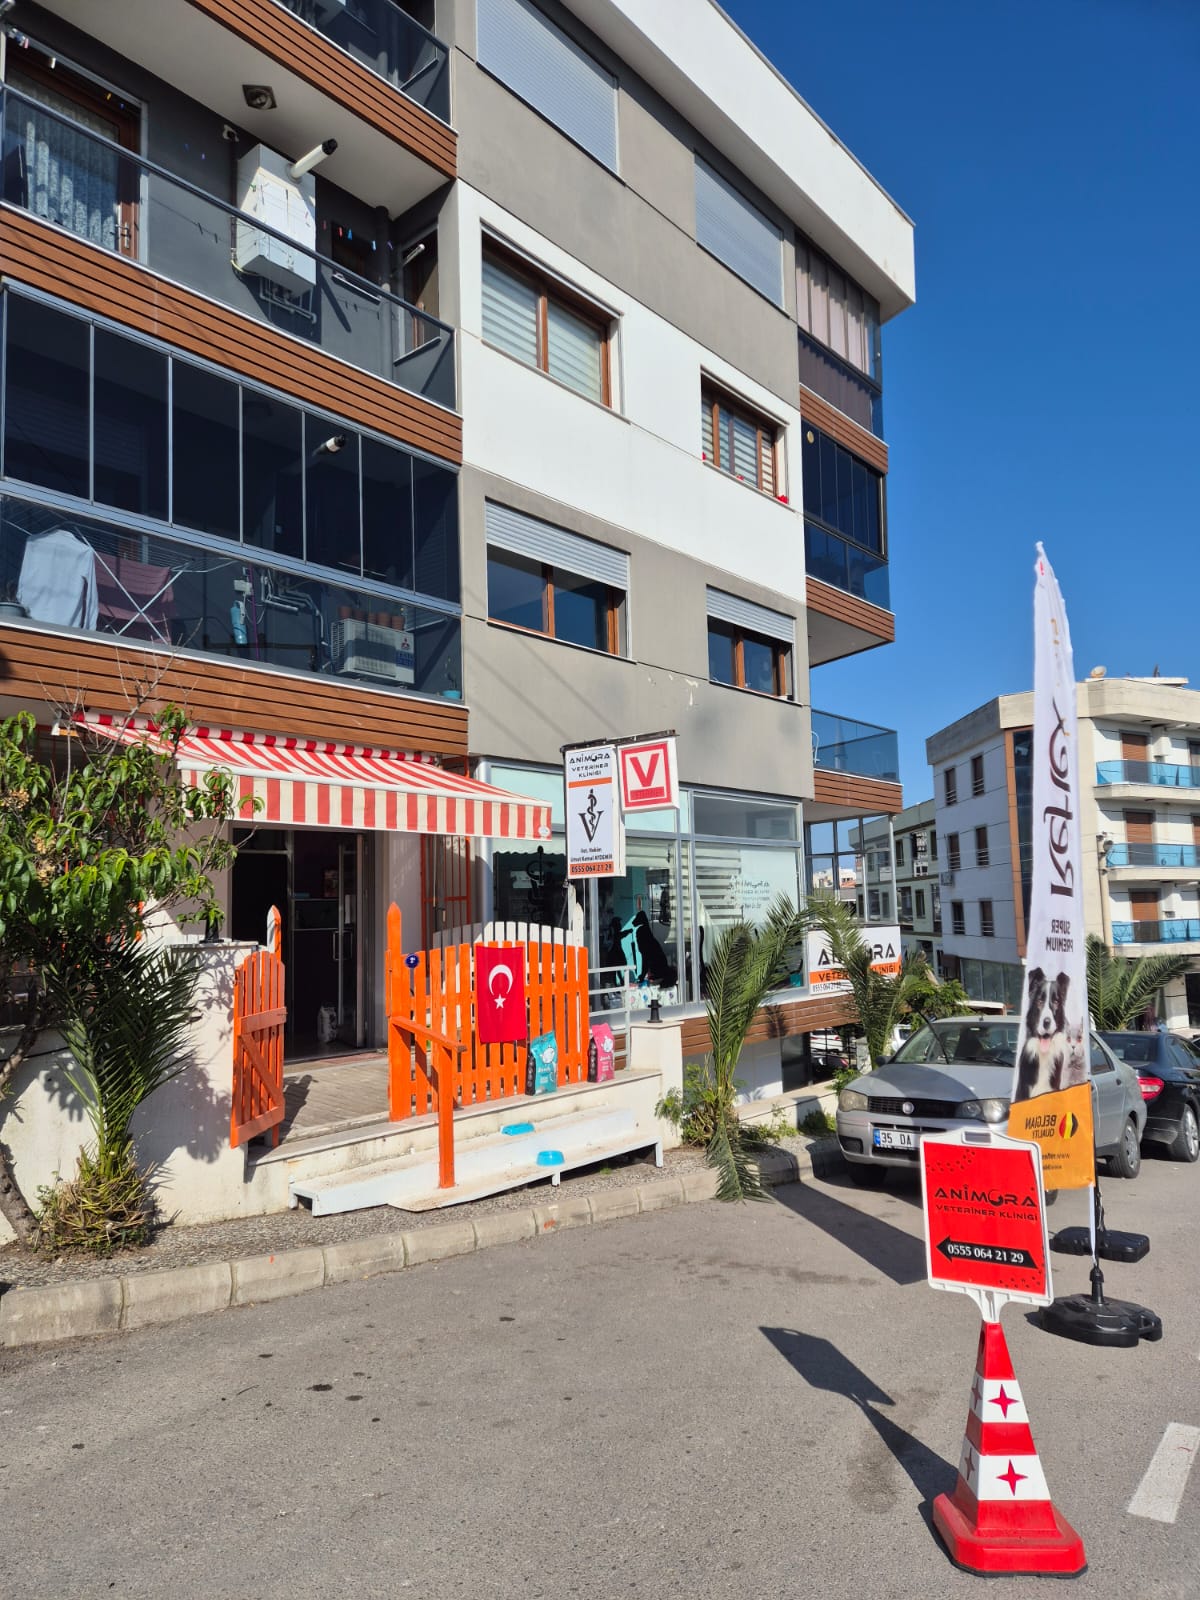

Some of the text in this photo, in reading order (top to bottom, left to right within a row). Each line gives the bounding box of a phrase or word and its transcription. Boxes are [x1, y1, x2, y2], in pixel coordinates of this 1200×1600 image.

[881, 1132, 912, 1145] 35 DA
[934, 1184, 1037, 1207] ANİMORA
[936, 1204, 996, 1217] VETERİNER
[947, 1243, 1025, 1264] 0555 064 21 29
